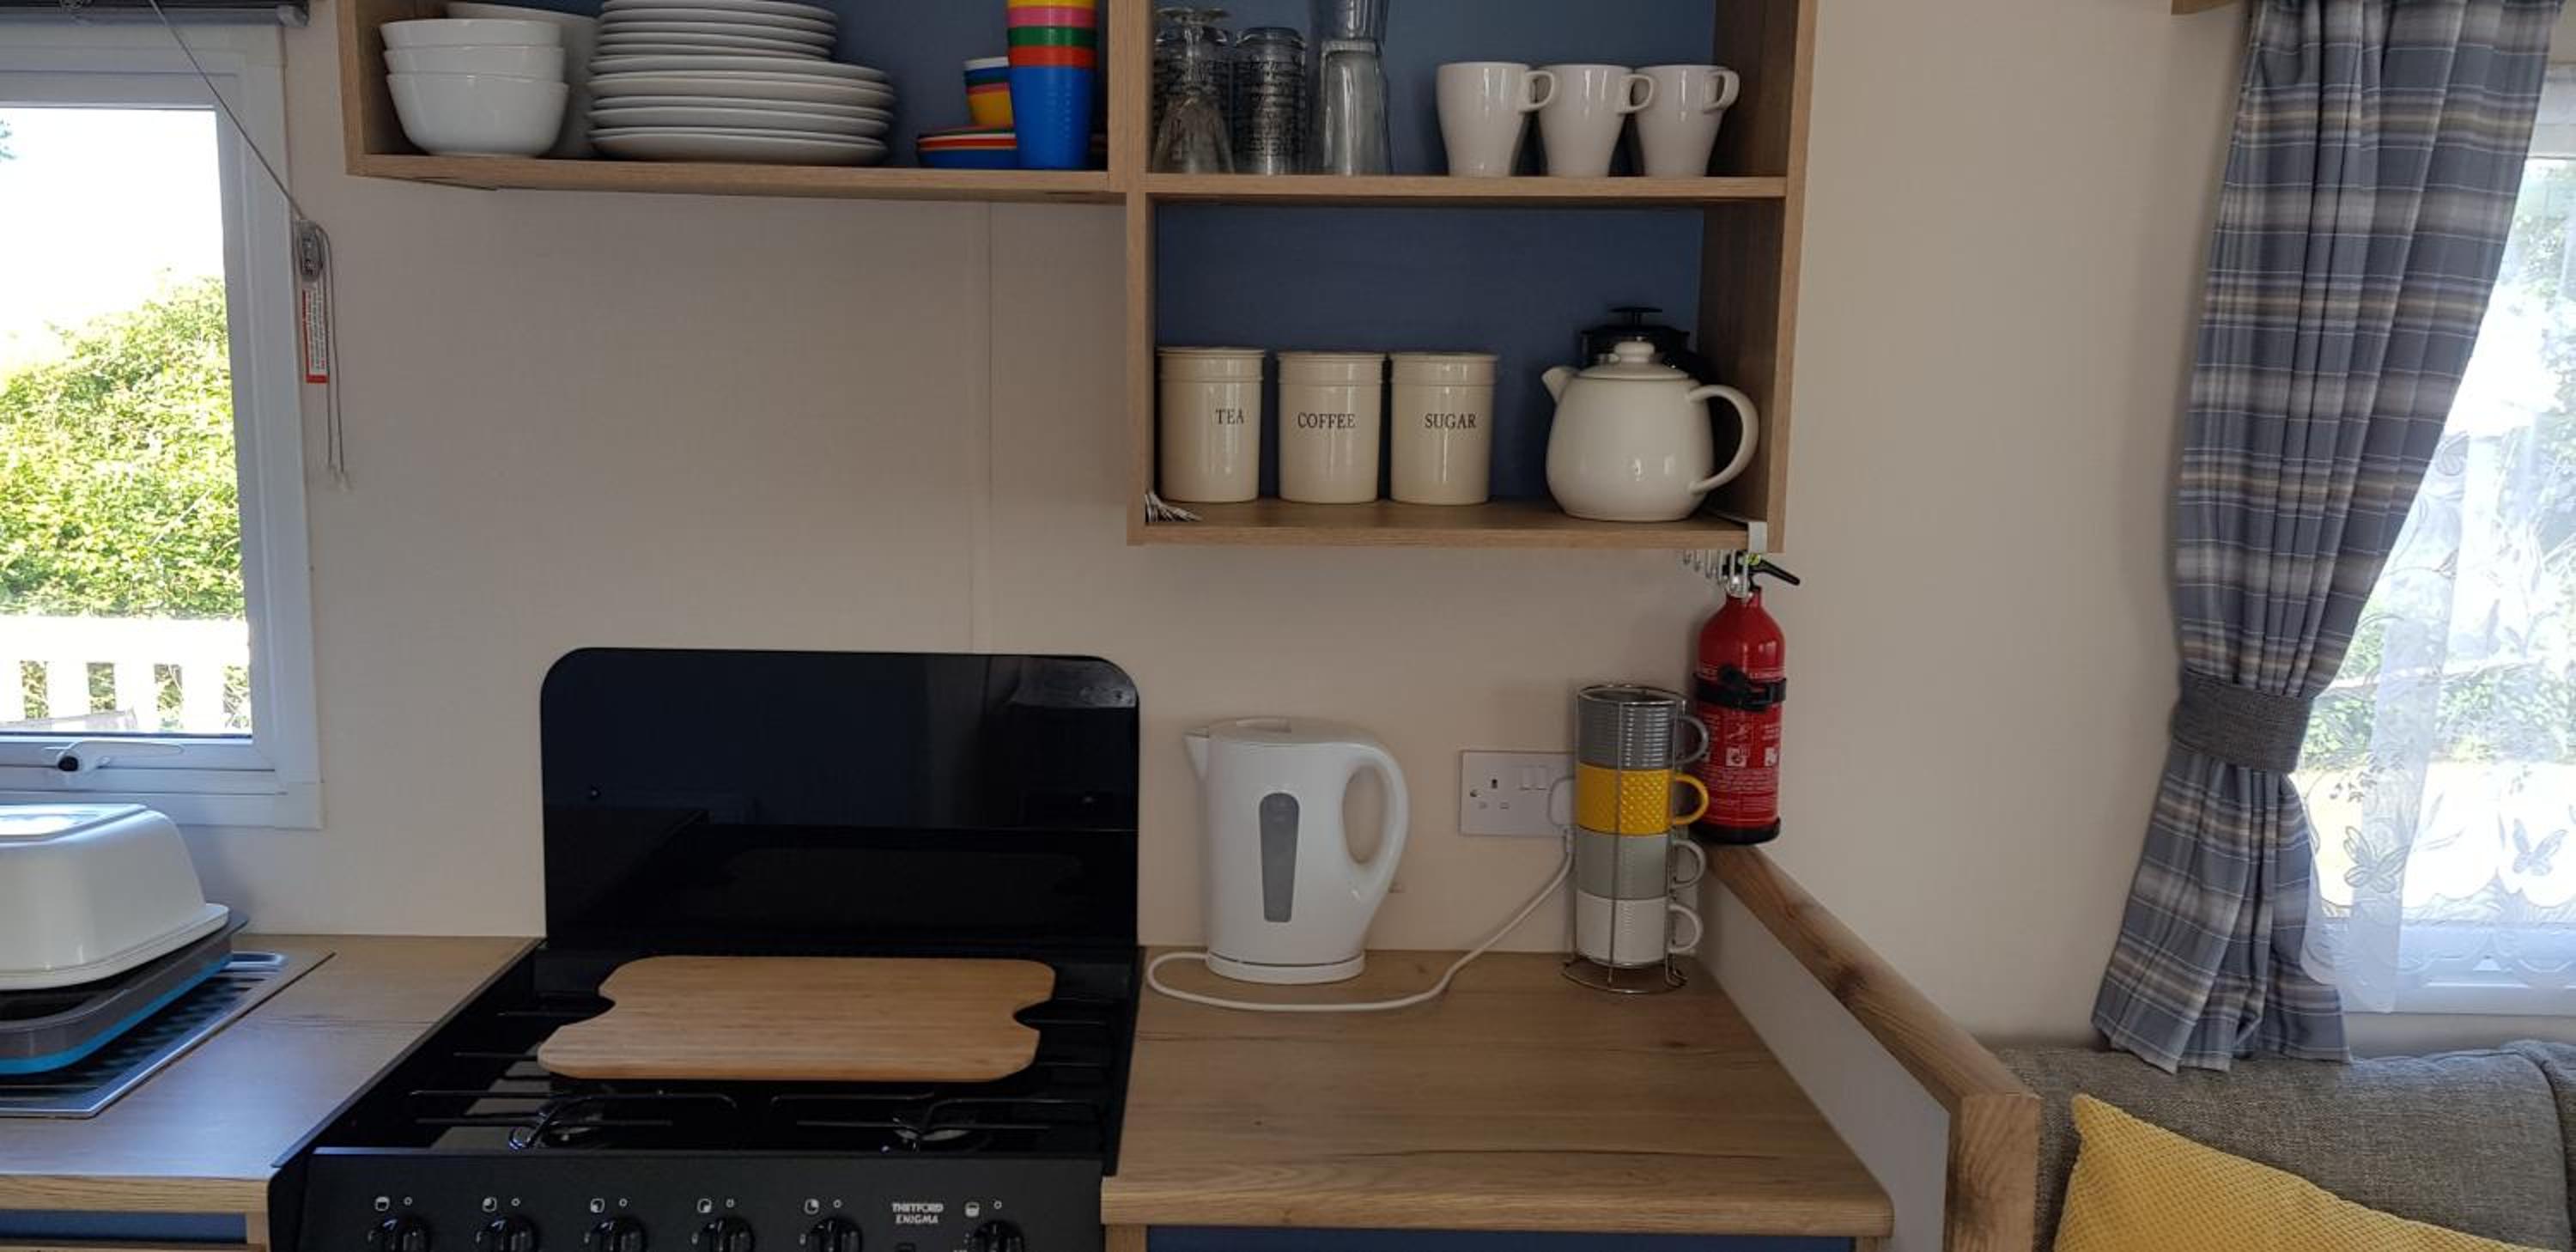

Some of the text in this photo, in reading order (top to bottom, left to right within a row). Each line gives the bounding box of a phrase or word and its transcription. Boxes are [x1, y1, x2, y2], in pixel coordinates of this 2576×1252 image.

[1215, 409, 1244, 425] TEA
[1297, 412, 1356, 429] COFFEE
[1425, 413, 1476, 429] SUGAR
[896, 1214, 939, 1224] ENIGMA
